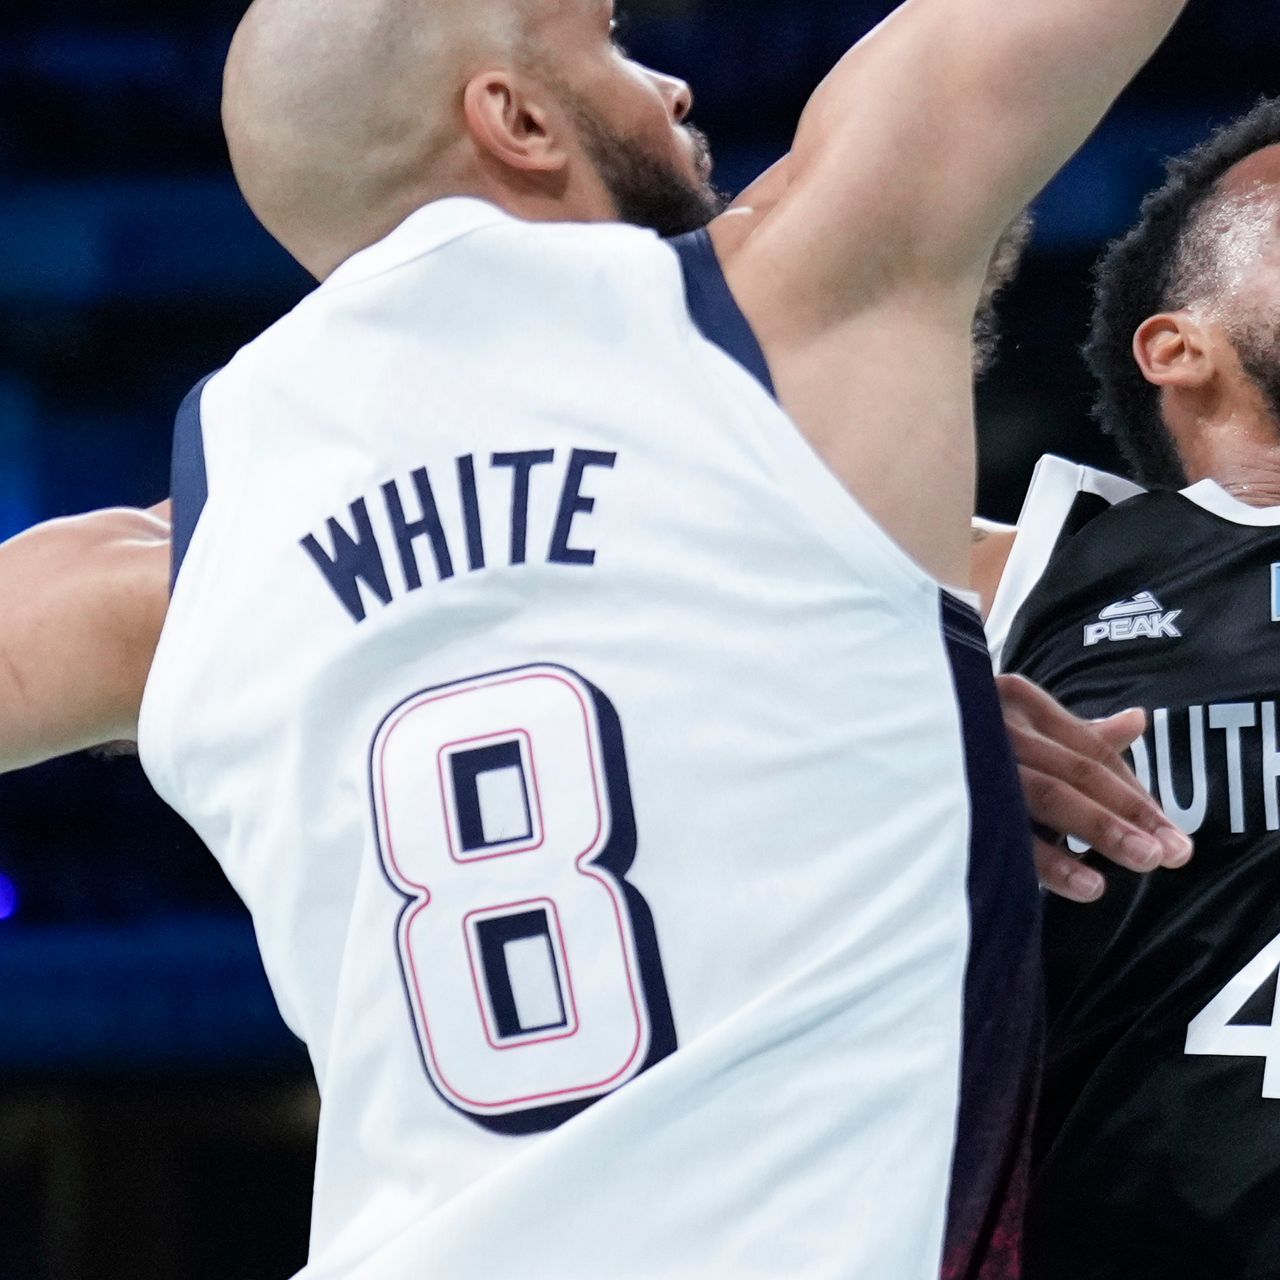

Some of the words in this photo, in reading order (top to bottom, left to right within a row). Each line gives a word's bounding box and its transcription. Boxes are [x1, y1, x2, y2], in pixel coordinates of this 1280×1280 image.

[300, 448, 617, 623] WHITE
[1083, 609, 1182, 646] PEAK
[371, 663, 678, 1135] 8
